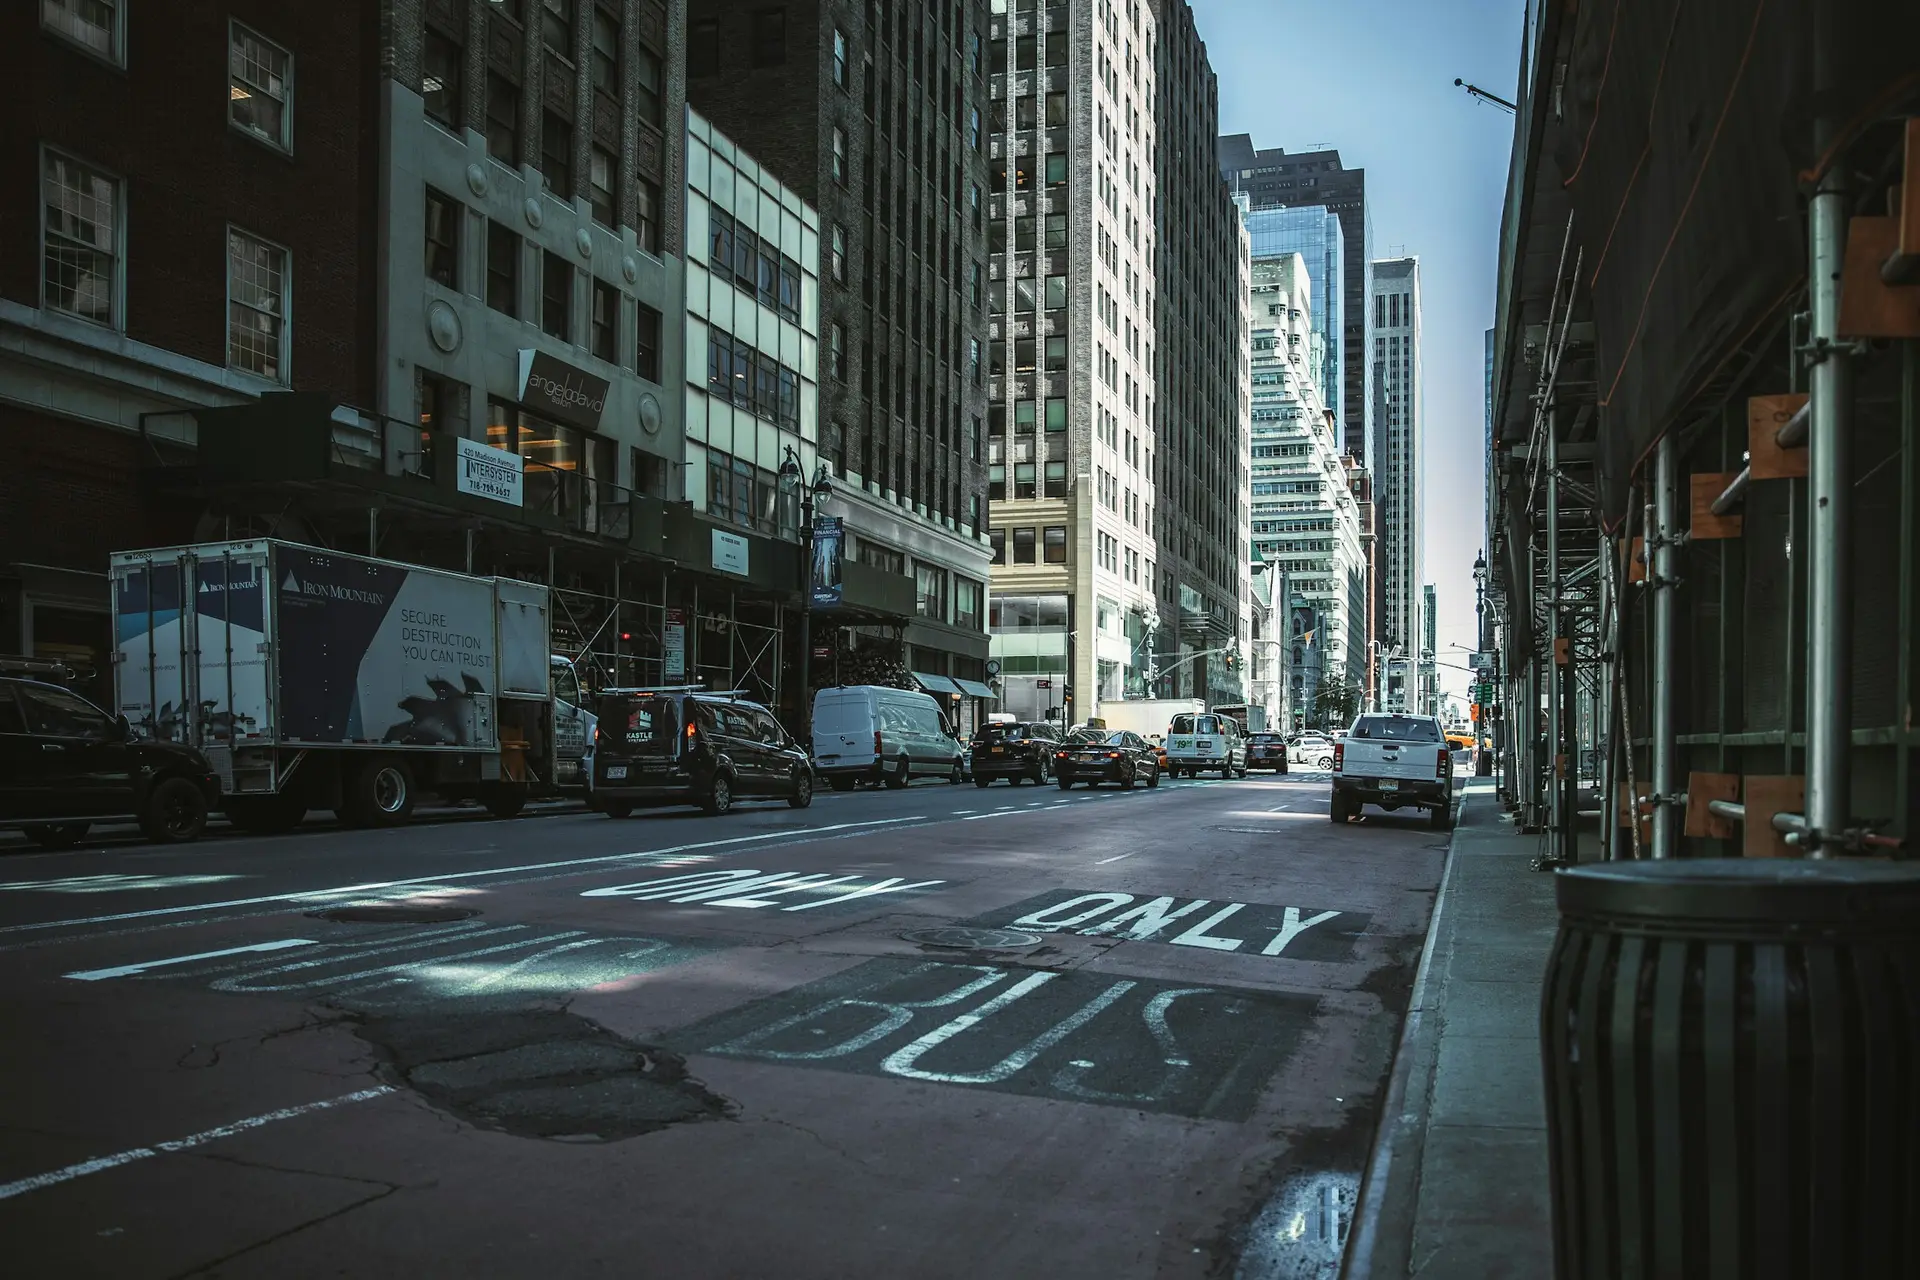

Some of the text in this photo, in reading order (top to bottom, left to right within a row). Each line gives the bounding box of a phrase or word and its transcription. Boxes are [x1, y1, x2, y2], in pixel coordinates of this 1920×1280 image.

[463, 448, 516, 469] 420 Madison Avenue
[464, 459, 516, 484] INTERSYSTEM
[303, 580, 329, 597] IRON
[329, 584, 383, 605] MOUNTAIN
[401, 609, 448, 628] SECURE
[402, 628, 482, 650] DESTRUCTION
[402, 645, 491, 668] YOU CAN TRUST
[580, 868, 947, 911] ONLY
[1012, 892, 1343, 956] ONLY
[707, 960, 1240, 1103] BUS
